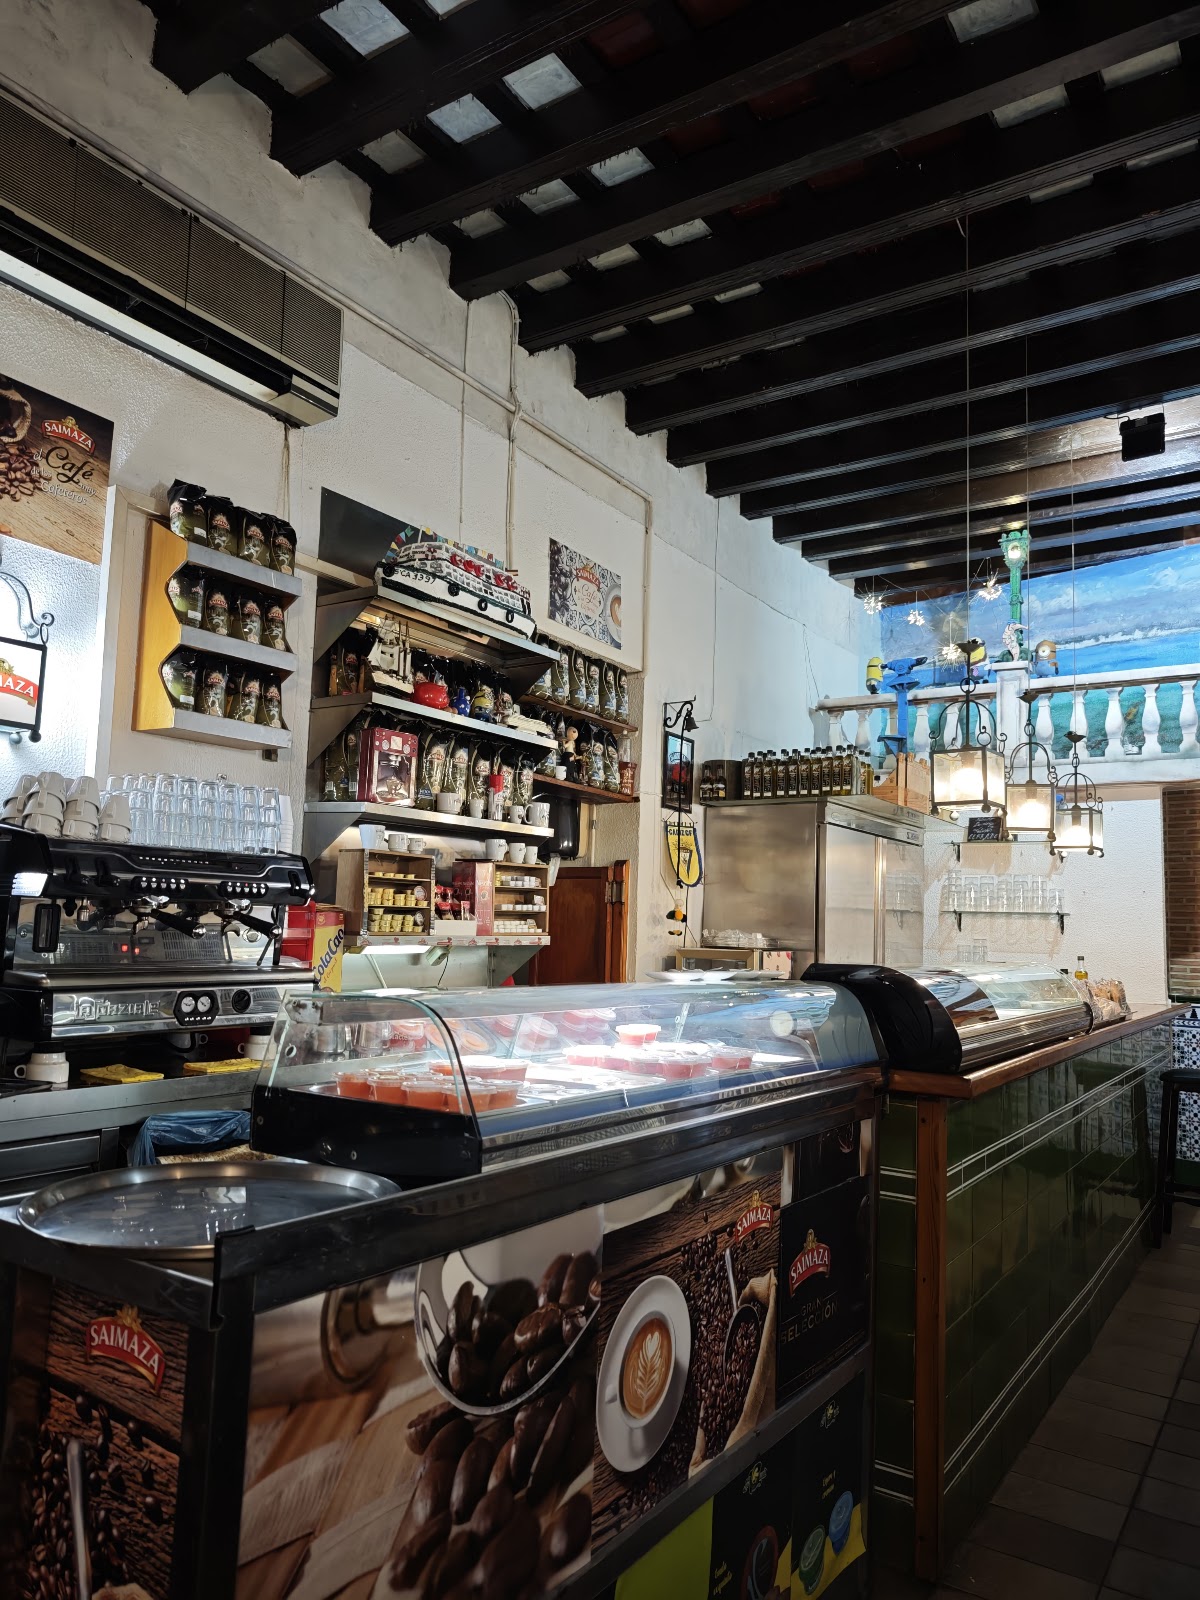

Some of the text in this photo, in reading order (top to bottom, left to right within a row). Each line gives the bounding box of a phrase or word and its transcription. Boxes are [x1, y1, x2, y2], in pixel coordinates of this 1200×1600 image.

[44, 422, 92, 448] SAIMAZA
[33, 446, 94, 484] el Café
[40, 480, 87, 505] Cafeteros
[0, 675, 34, 698] AZA
[737, 1207, 771, 1236] SAIMAZA
[791, 1249, 828, 1284] SAIMAZA
[801, 1296, 822, 1316] GRAN
[780, 1300, 838, 1345] SELECCIÓN
[90, 1324, 159, 1376] SAIMAZA
